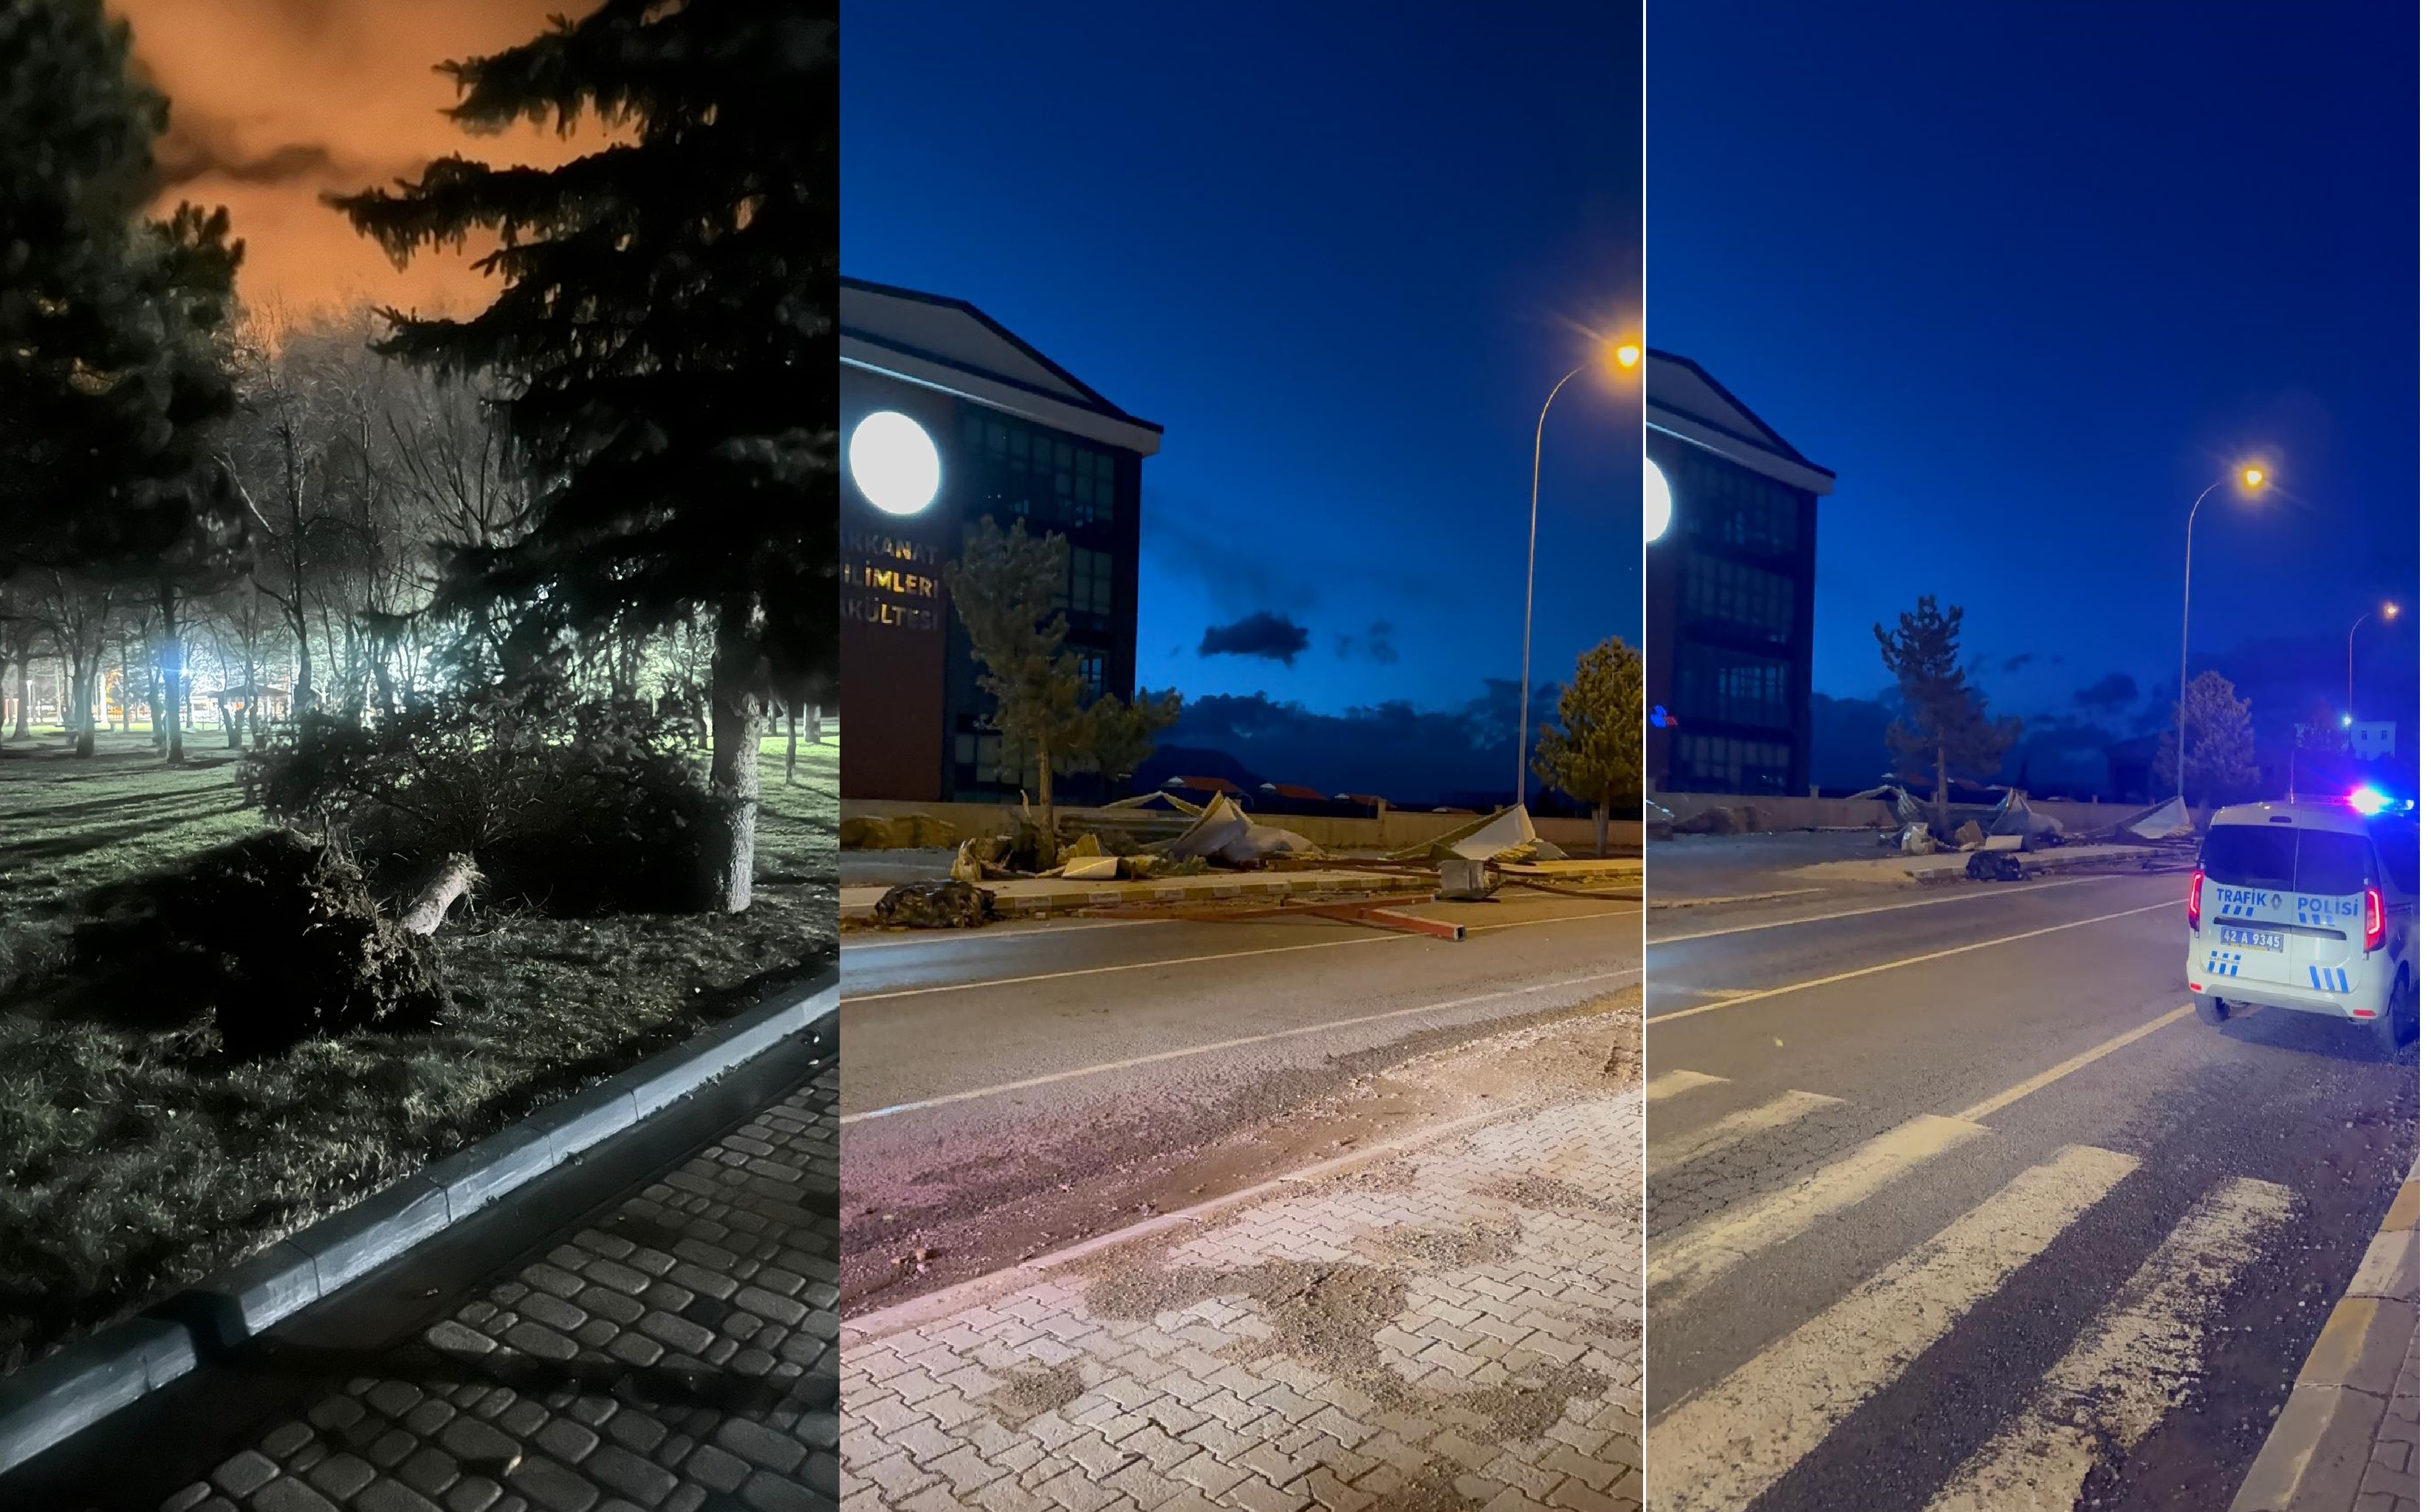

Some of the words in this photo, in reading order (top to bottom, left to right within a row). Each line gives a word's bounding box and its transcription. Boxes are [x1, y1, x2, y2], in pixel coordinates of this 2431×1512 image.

[2216, 888, 2267, 907] TRAFİK
[2297, 896, 2359, 917] POLİSİ
[2224, 930, 2237, 942] 42
[2241, 932, 2248, 944] A
[2253, 933, 2280, 947] 9345
